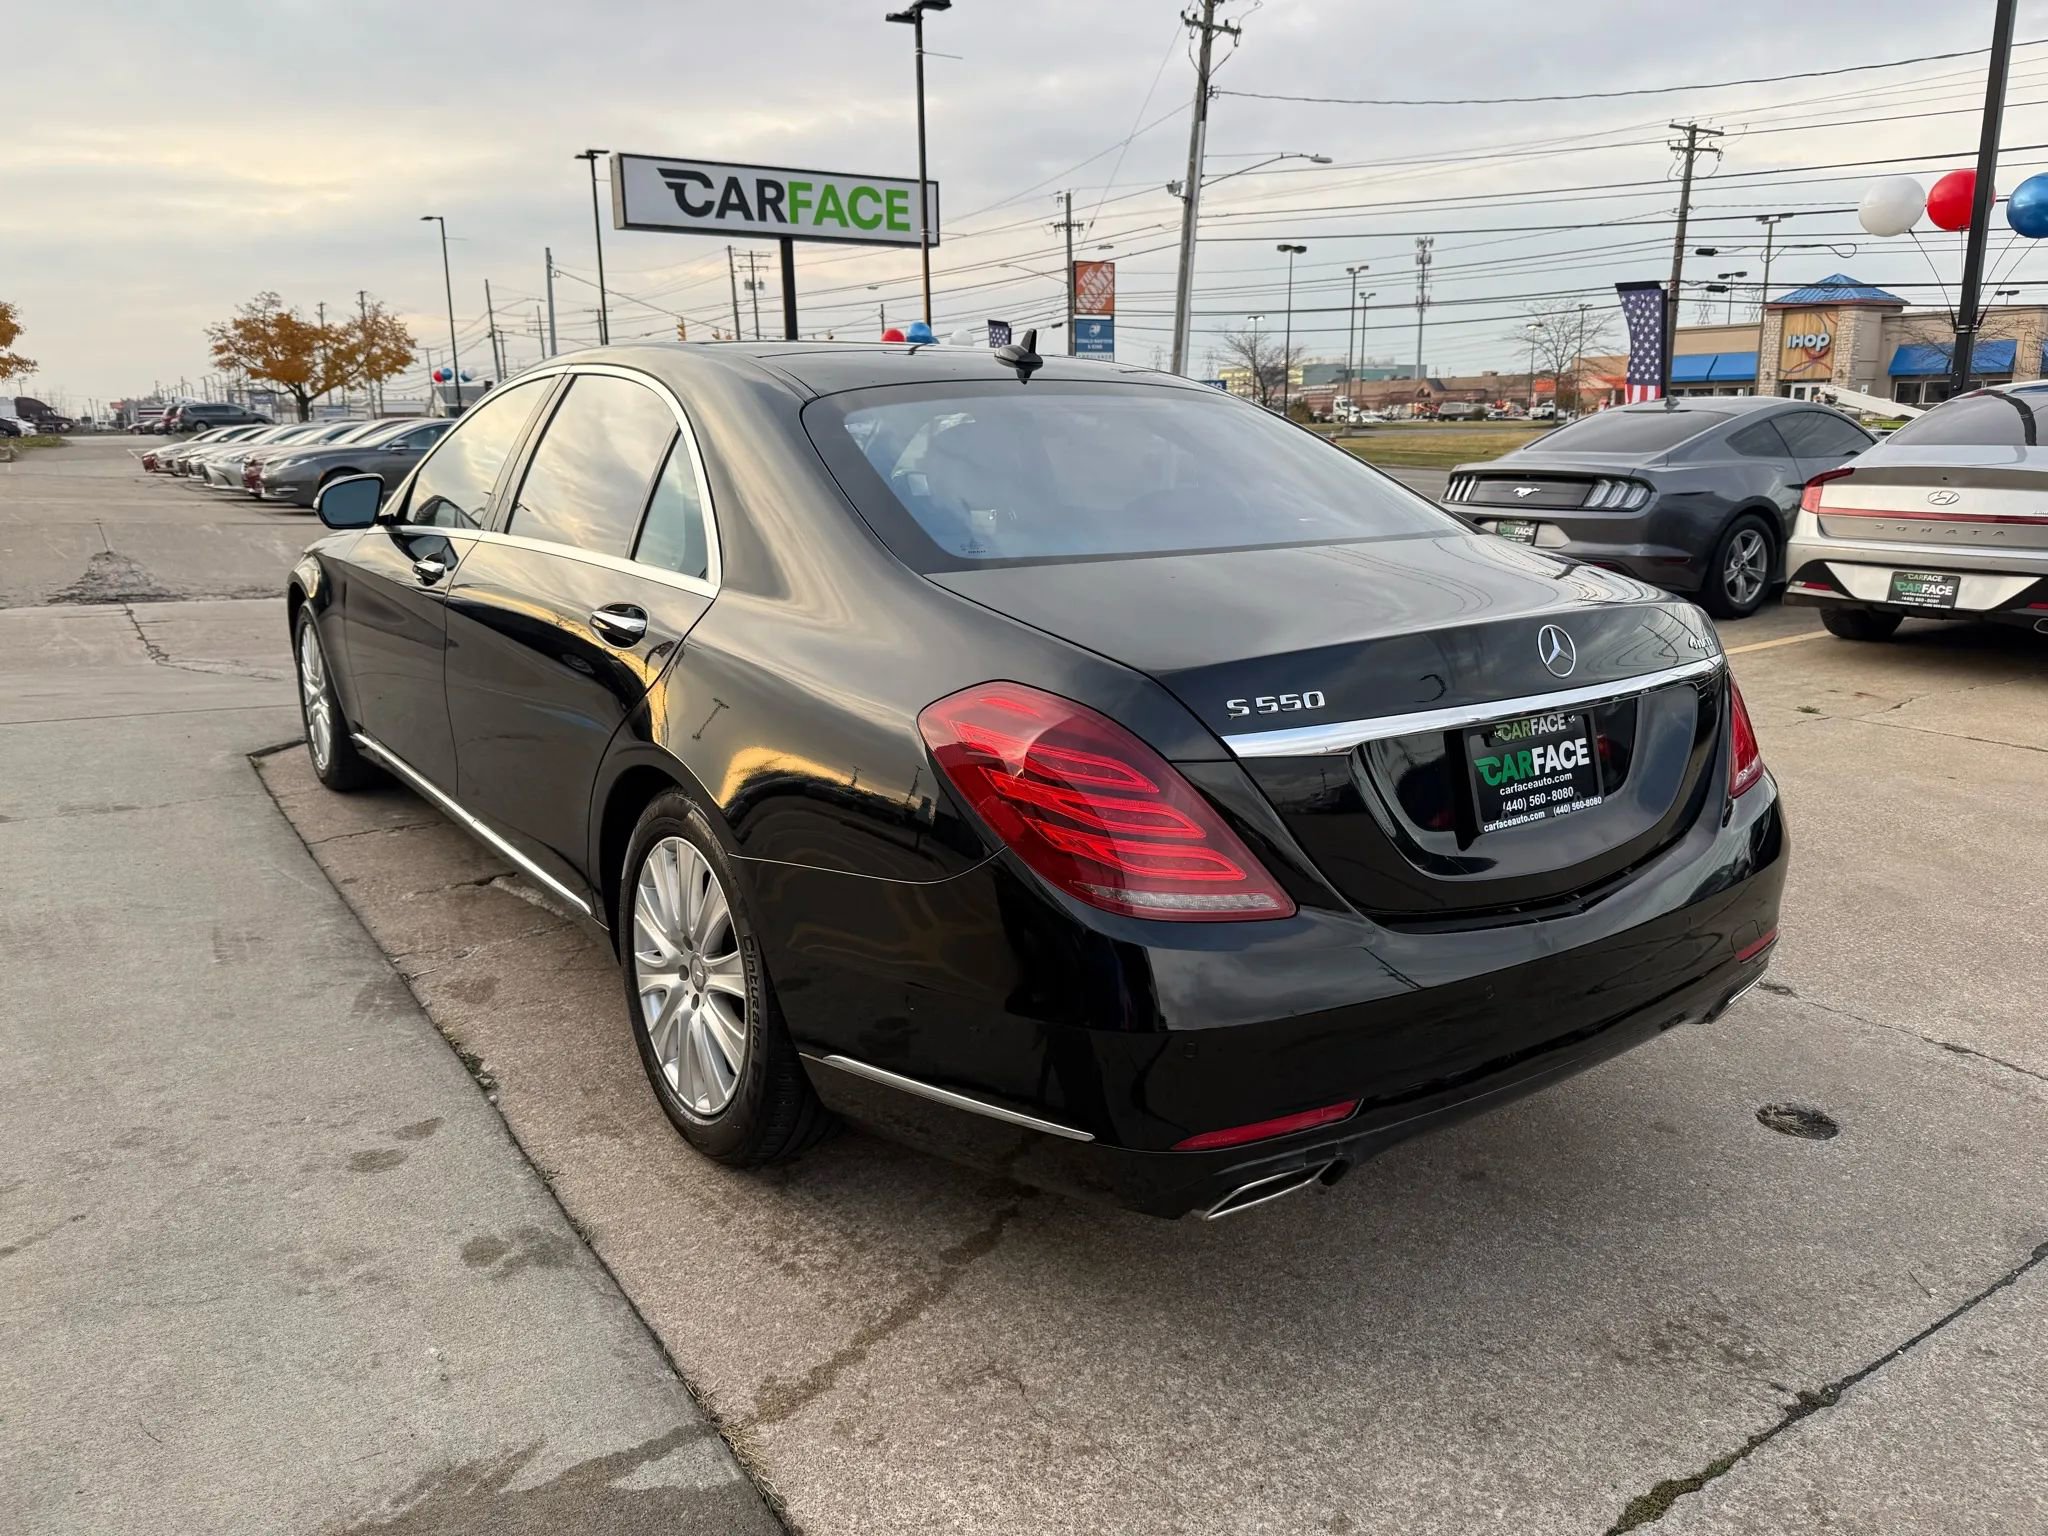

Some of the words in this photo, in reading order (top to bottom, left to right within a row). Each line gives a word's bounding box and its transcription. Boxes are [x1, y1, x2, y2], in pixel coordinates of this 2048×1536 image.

[656, 167, 911, 232] CARFACE
[1874, 523, 2006, 537] SONATA
[1895, 581, 1954, 596] CARFACE
[1226, 698, 1250, 717] S
[1255, 690, 1326, 715] 550
[1496, 713, 1567, 742] CARFACE
[1473, 737, 1590, 786] CARFACE
[1499, 772, 1573, 796] carfaceauto.com
[1502, 798, 1527, 813] (440)
[1553, 803, 1571, 817] (440)
[1571, 796, 1602, 811] 560-8080
[1483, 810, 1545, 833] carfaceauto.com
[743, 935, 762, 1050] Cinturato
